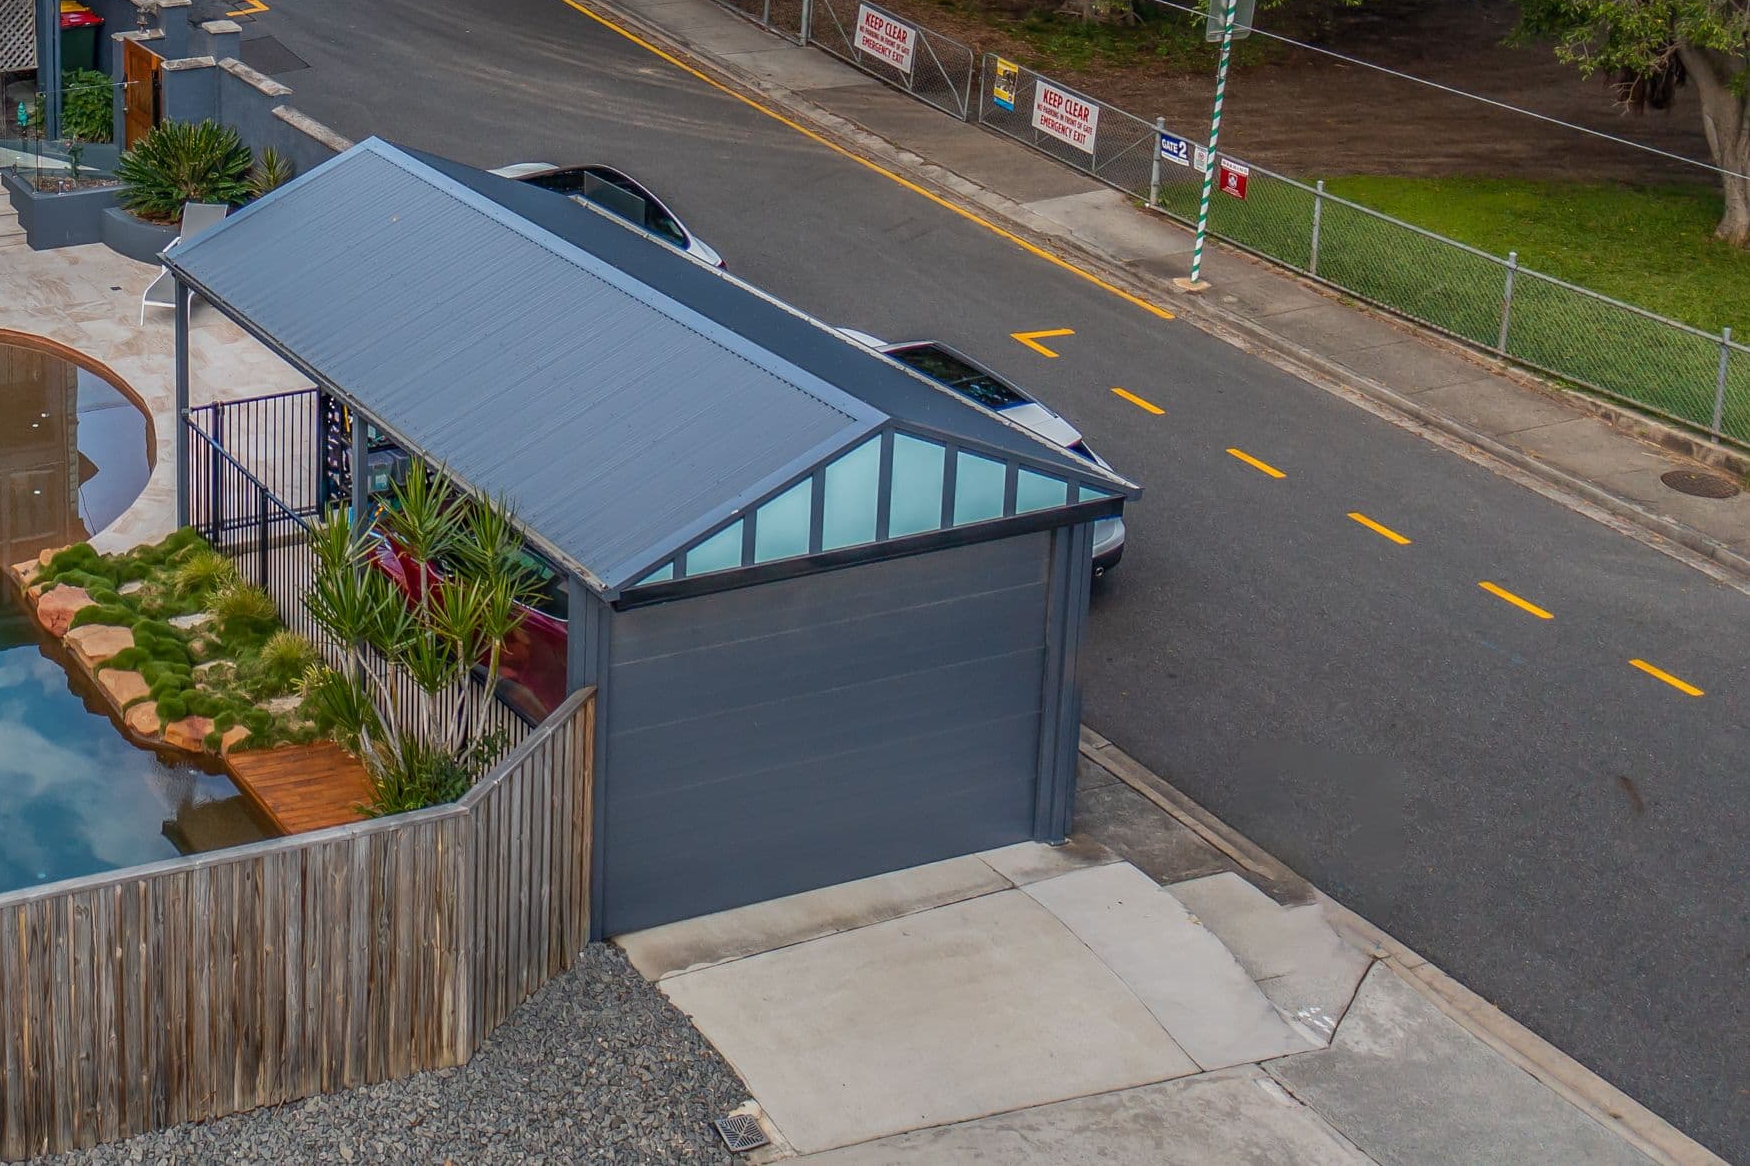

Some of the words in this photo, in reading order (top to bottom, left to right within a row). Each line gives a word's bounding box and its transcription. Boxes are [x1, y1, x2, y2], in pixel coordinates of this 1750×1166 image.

[865, 12, 884, 31] KEEP
[885, 22, 908, 44] CLEAR
[862, 36, 892, 58] EMERGENCY
[892, 51, 904, 65] EXIT
[1043, 88, 1063, 109] KEEP
[1065, 98, 1090, 122] CLEAR
[1040, 114, 1073, 138] EMERGENCY
[1073, 130, 1087, 145] EXIT
[1161, 138, 1178, 153] GATE
[1178, 141, 1187, 159] 2
